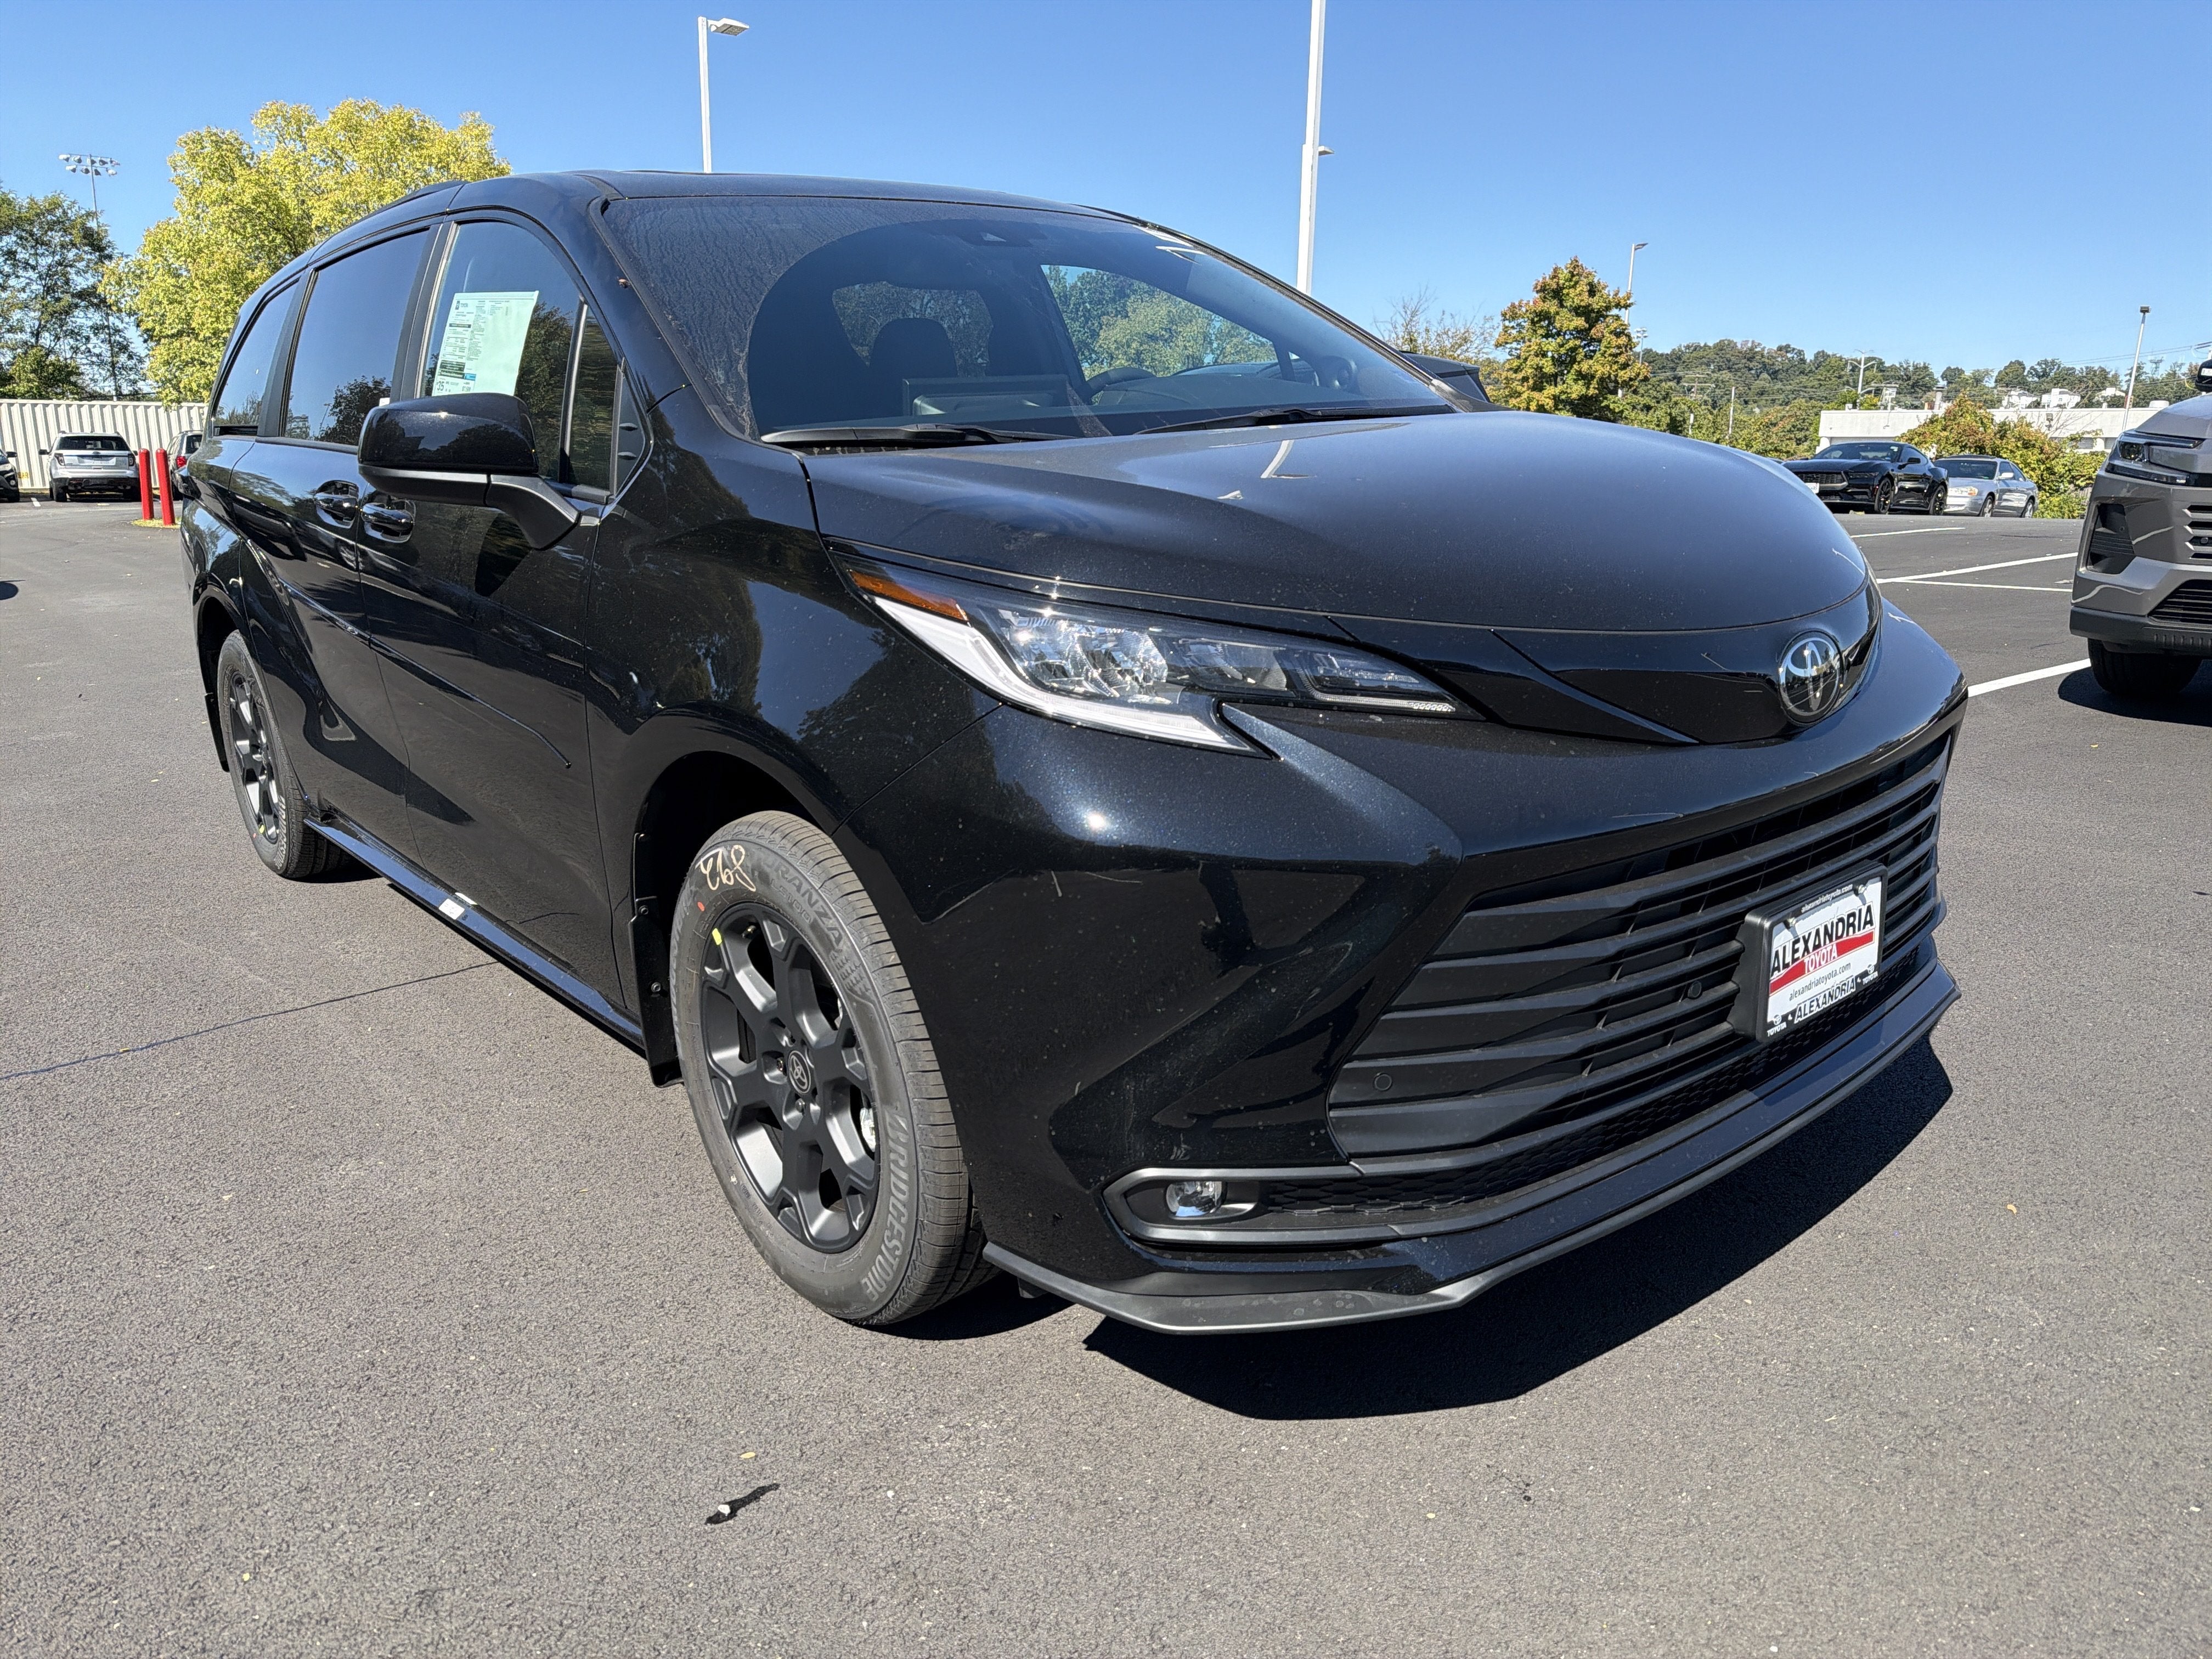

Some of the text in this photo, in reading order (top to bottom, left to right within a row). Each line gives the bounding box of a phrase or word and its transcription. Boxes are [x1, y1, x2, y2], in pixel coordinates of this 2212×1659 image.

[752, 854, 844, 947] URANZA
[1801, 884, 1853, 913] alexandriatoyota.com
[1771, 903, 1875, 978] ALEXANDRIA
[1804, 944, 1838, 974] TOYOTA
[1789, 962, 1851, 1001] alexandriatoyota.com
[1863, 971, 1878, 985] TOYOTA
[1794, 976, 1856, 1024] ALEXANDRIA
[1767, 1022, 1787, 1037] TOYOTA
[860, 1111, 910, 1301] BRIDGESTONE
